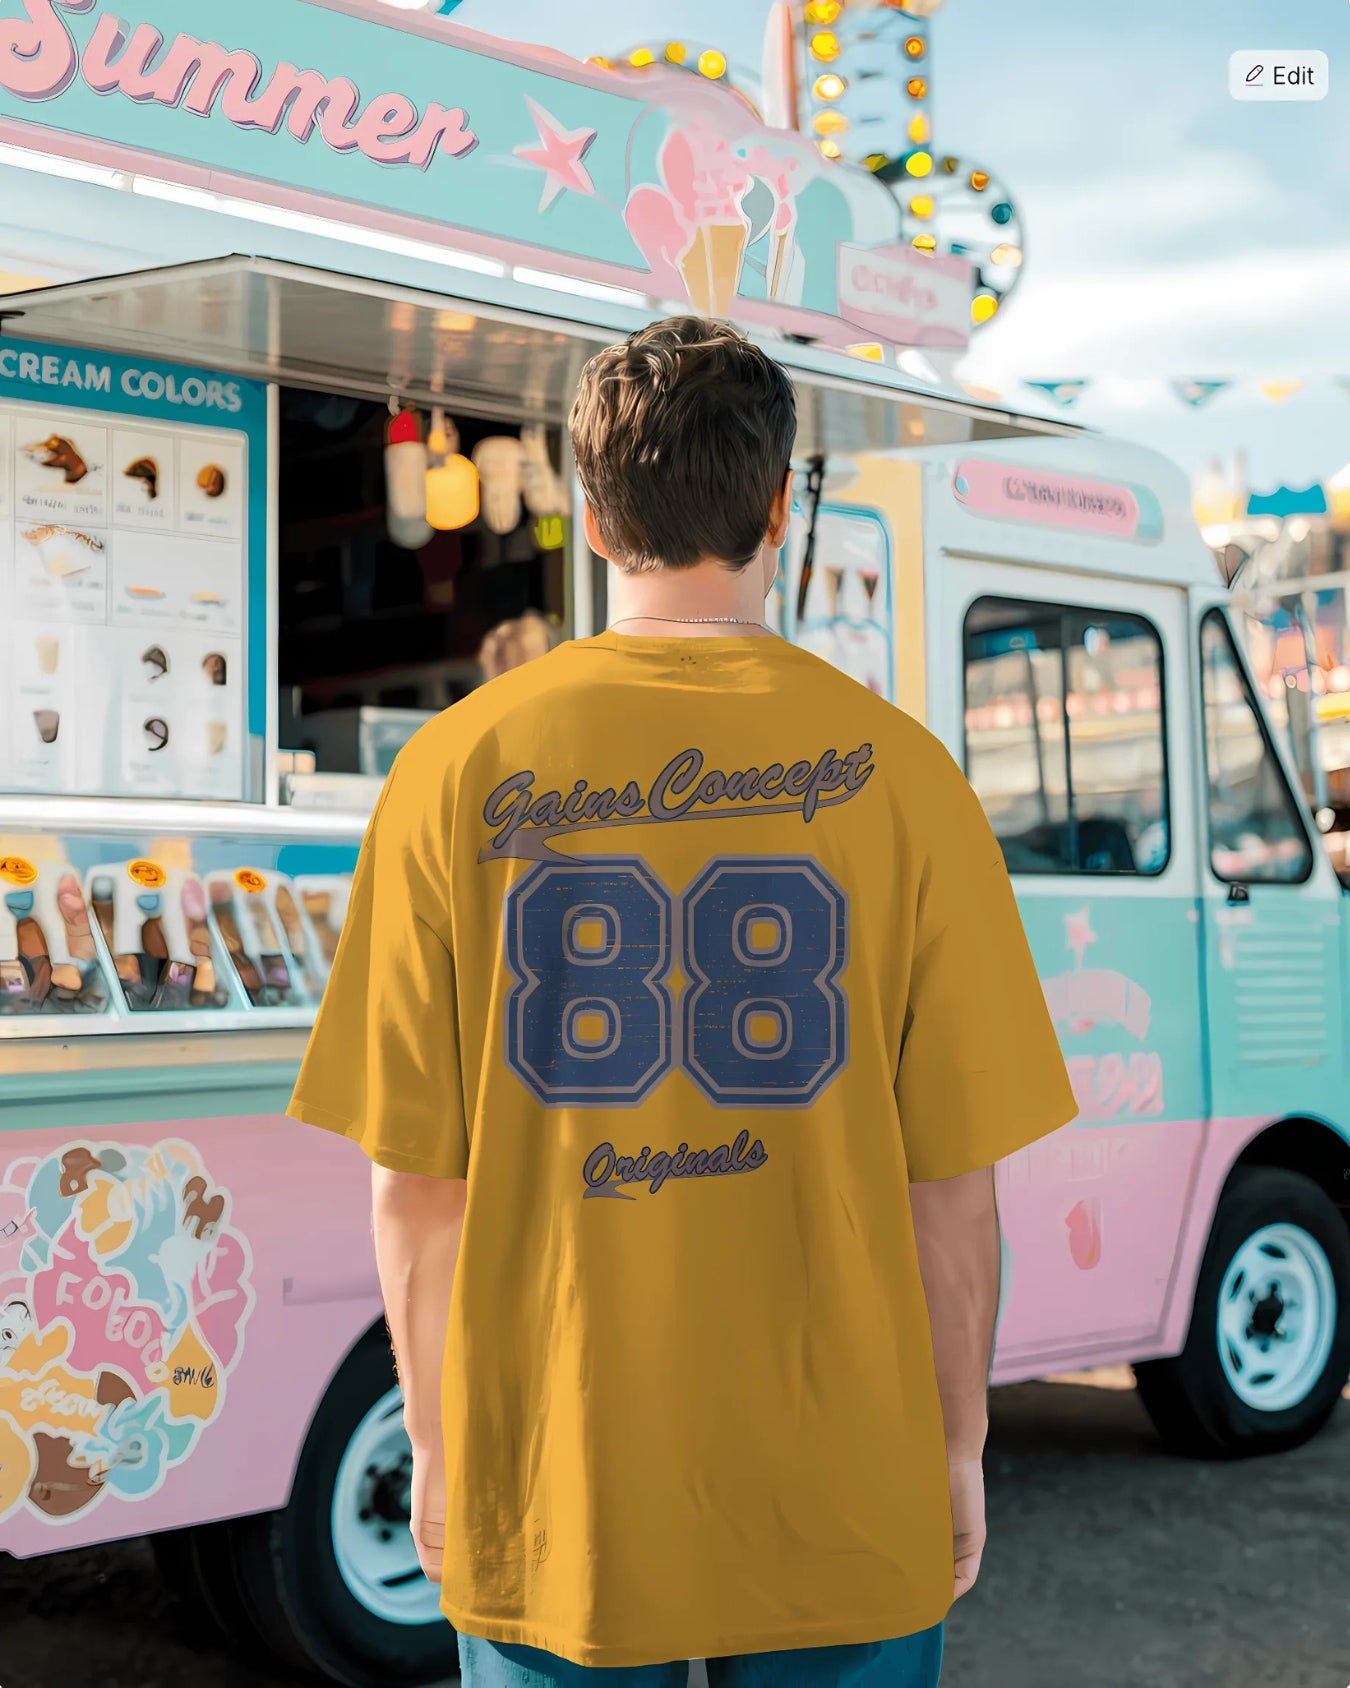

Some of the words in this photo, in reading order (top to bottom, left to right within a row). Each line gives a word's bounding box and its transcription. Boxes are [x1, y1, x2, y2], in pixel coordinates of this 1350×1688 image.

[0, 0, 479, 173] Summer
[0, 349, 111, 393] CREAM
[120, 368, 242, 413] COLORS
[483, 770, 645, 849] Gains
[648, 743, 875, 823] Concept
[503, 853, 850, 1110] 88
[582, 1129, 768, 1194] Originals
